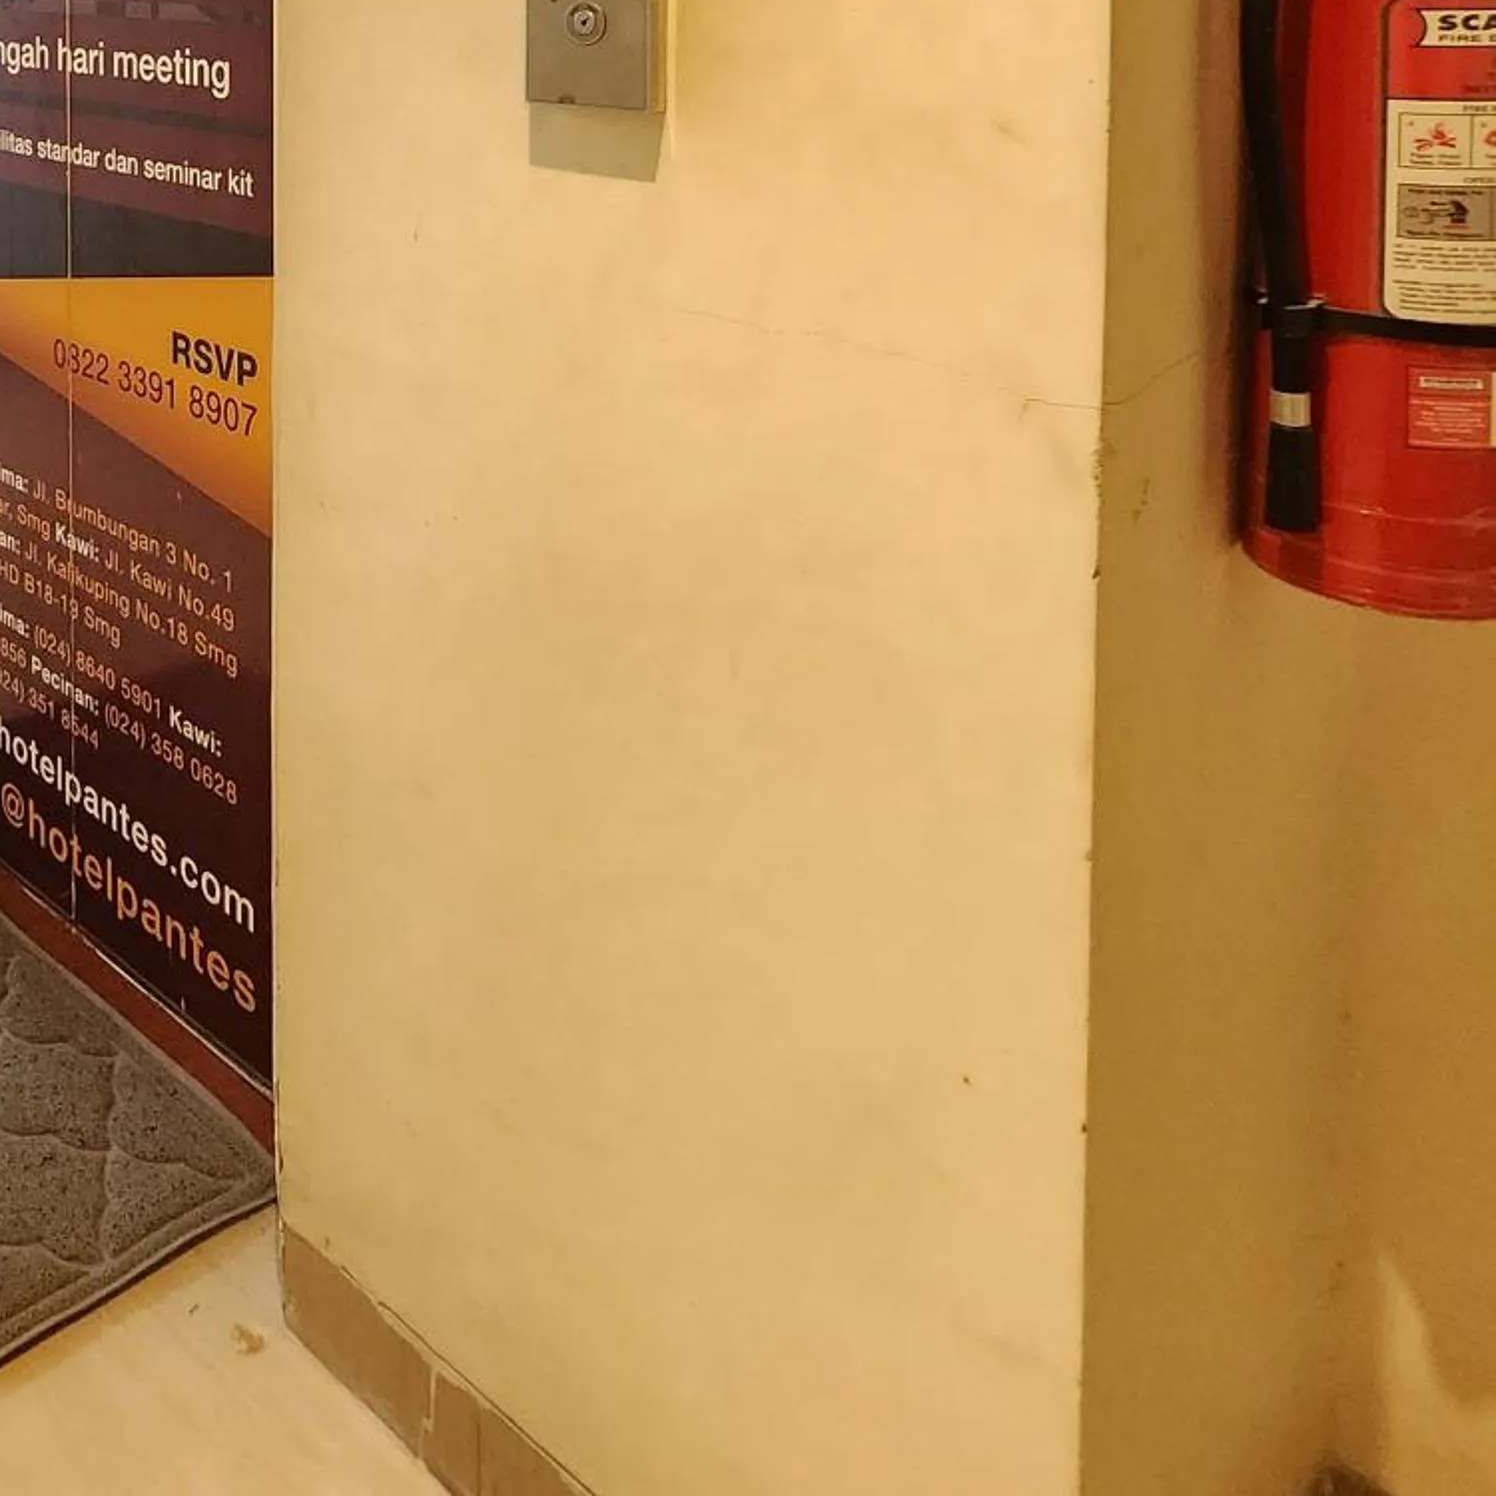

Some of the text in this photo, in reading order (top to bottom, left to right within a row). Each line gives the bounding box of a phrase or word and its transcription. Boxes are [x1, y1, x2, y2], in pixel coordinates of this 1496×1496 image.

[57, 37, 105, 77] hari
[113, 48, 231, 99] meeting
[37, 138, 101, 168] standar
[105, 148, 139, 175] dan
[143, 156, 222, 191] seminar
[228, 167, 255, 198] kit
[171, 331, 259, 387] RSVP
[117, 360, 176, 410] 3391
[189, 385, 258, 436] 8907
[17, 504, 51, 542] Smg
[55, 522, 100, 563] Kawi:
[130, 559, 173, 601] Kawi
[165, 542, 177, 565] 3
[183, 549, 216, 586] No.
[222, 569, 233, 594] 1
[84, 605, 121, 649] Smg
[135, 598, 189, 646] No.18
[194, 631, 238, 678] Smg
[34, 624, 71, 668] (024)
[120, 677, 161, 718] 5901
[168, 705, 222, 758] Kawi:
[31, 655, 100, 716] Pecinan:
[104, 702, 146, 750] (024)
[151, 732, 185, 770] 358
[190, 757, 238, 805] 0628
[1, 781, 257, 1014] @hotelpantes
